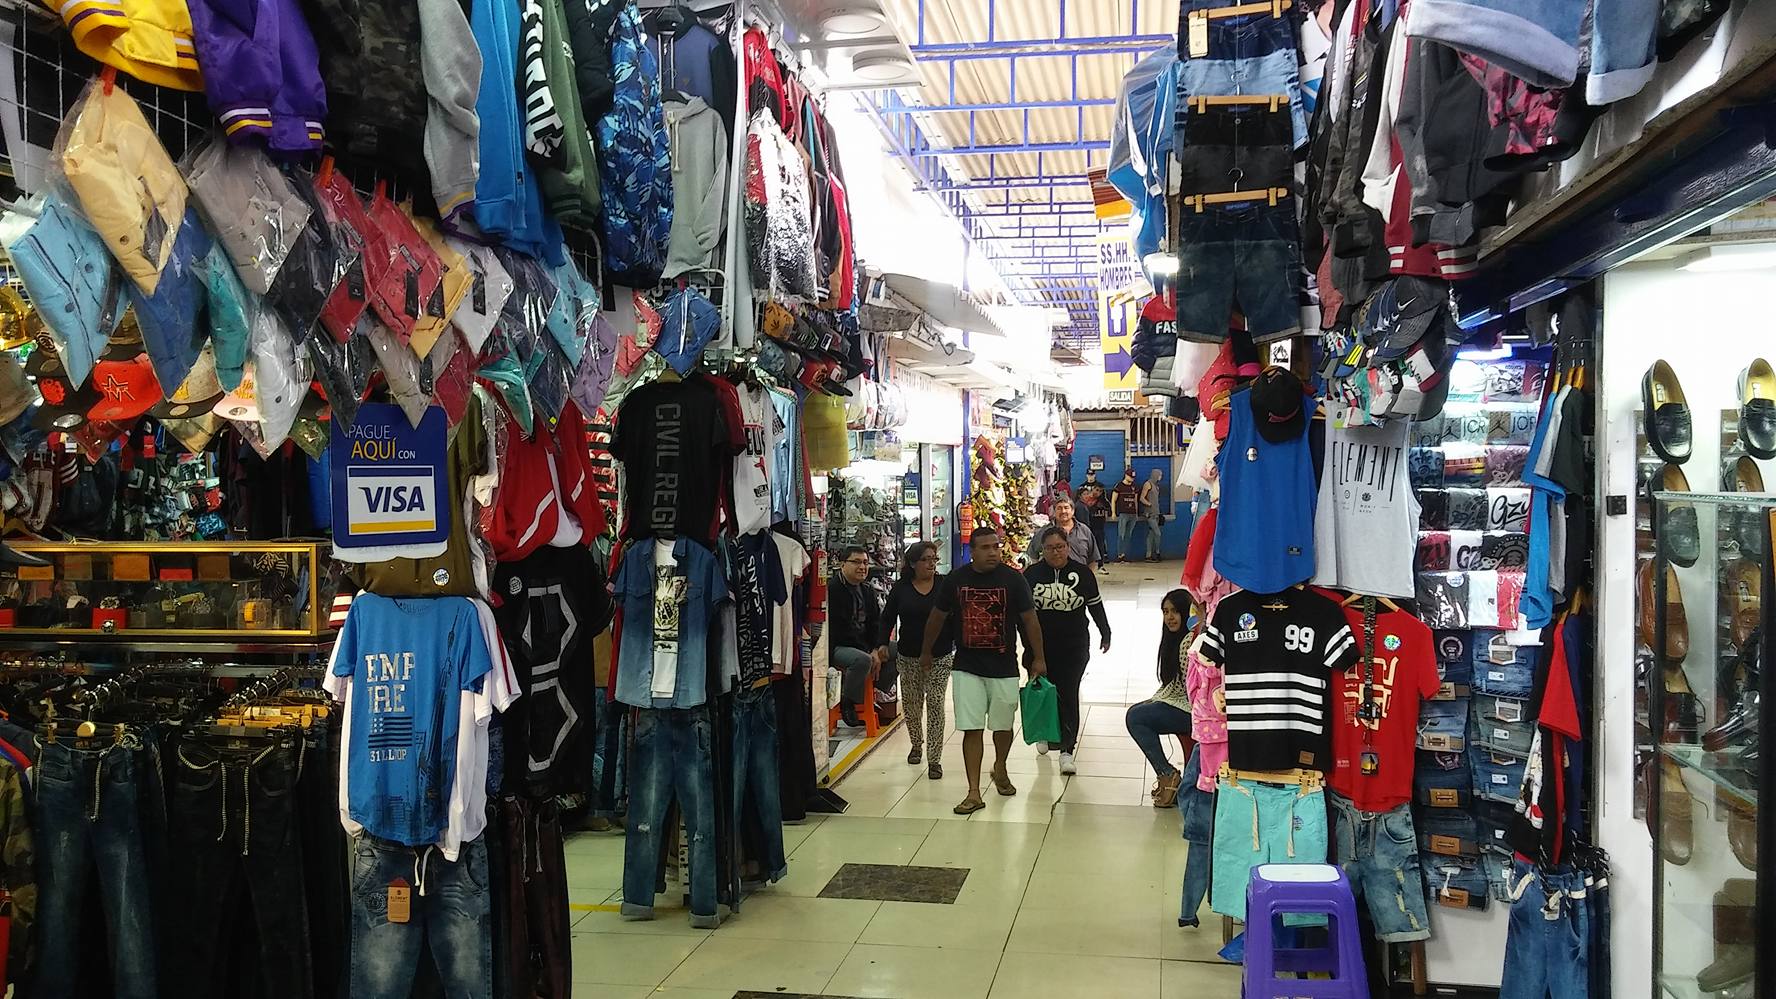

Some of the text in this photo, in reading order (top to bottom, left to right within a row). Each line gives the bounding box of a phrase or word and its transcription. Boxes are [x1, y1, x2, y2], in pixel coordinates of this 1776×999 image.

[1099, 266, 1133, 291] HOMBRES
[349, 424, 391, 440] PAGUE
[655, 404, 681, 468] CIVIL
[351, 437, 416, 461] AQUÍ CON
[358, 486, 426, 513] VISA
[905, 491, 917, 500] VISA
[1237, 630, 1256, 640] AXES
[1284, 623, 1315, 654] 99
